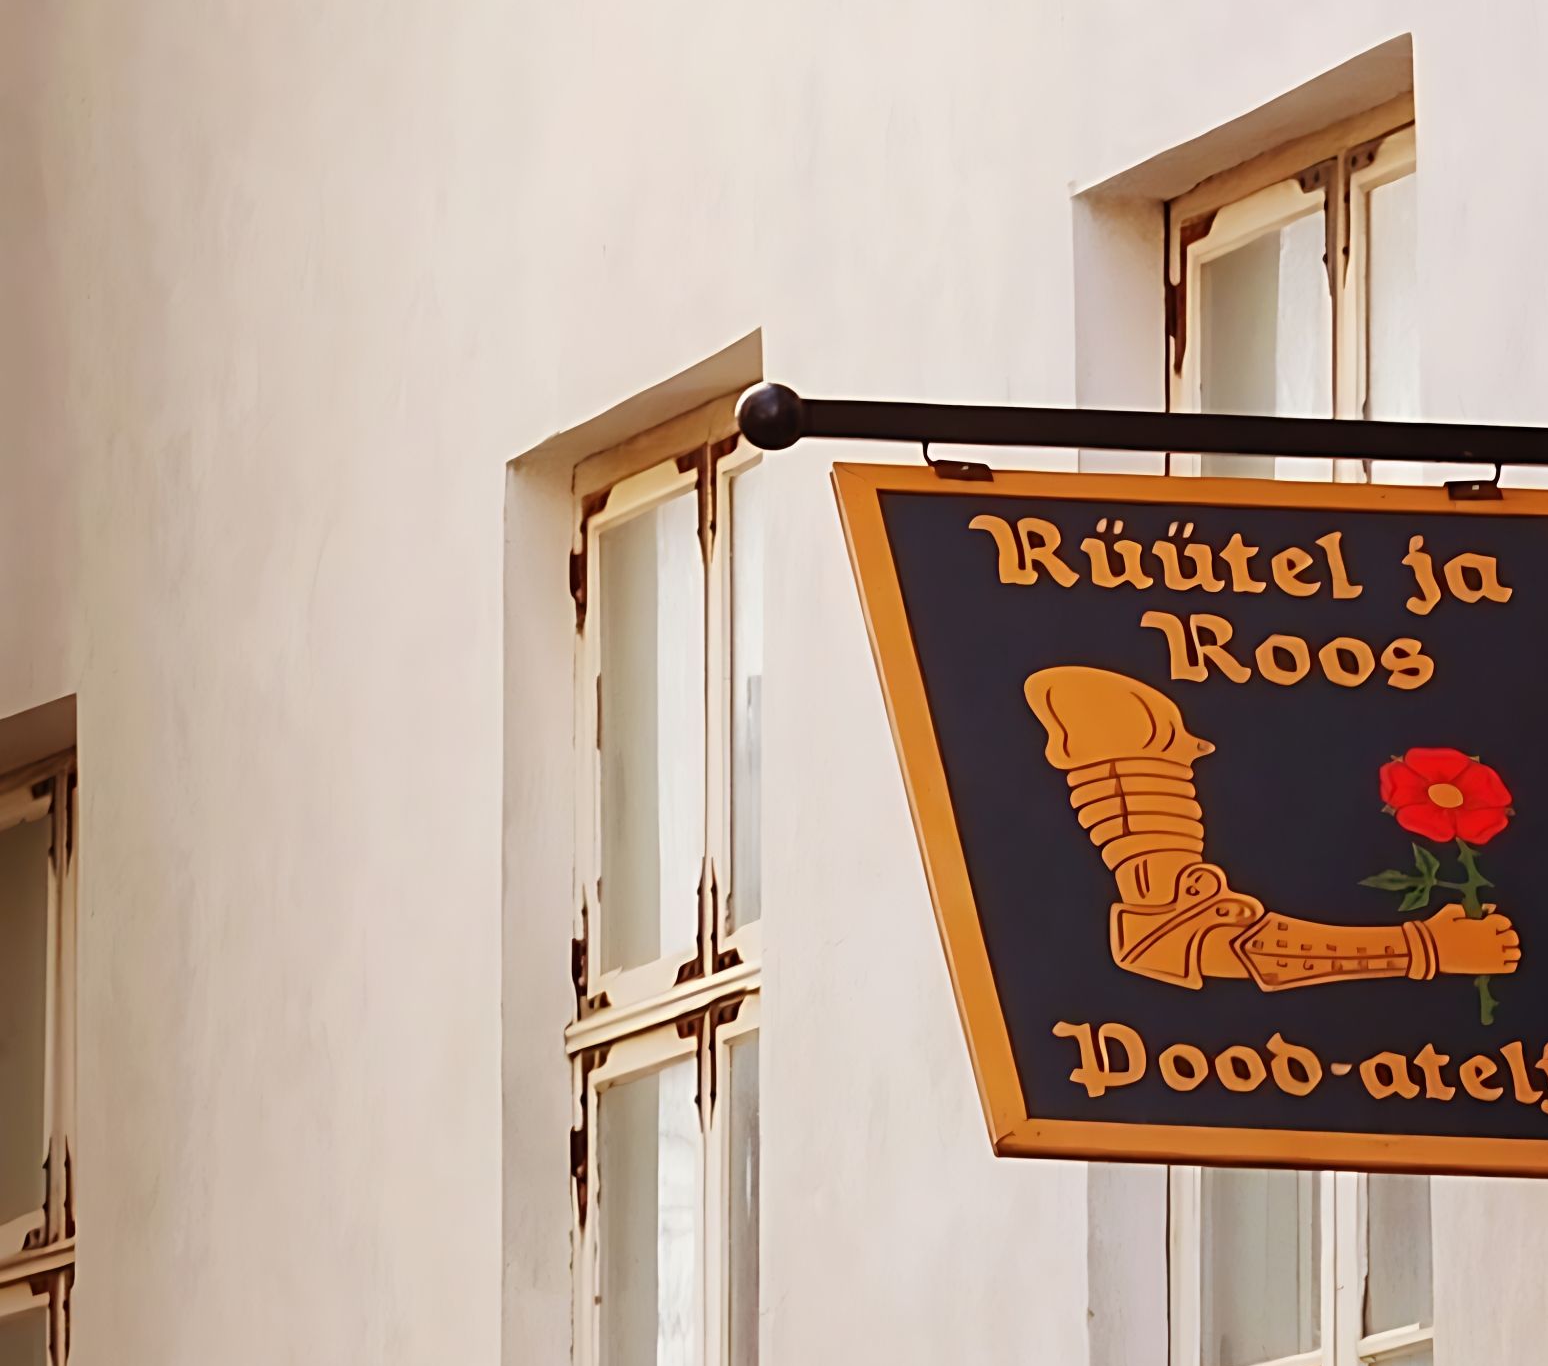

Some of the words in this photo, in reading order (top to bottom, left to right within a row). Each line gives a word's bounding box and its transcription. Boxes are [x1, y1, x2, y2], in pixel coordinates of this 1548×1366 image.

[968, 514, 1363, 600] Rüütel
[1401, 535, 1512, 616] ja
[1140, 610, 1434, 690] Roos
